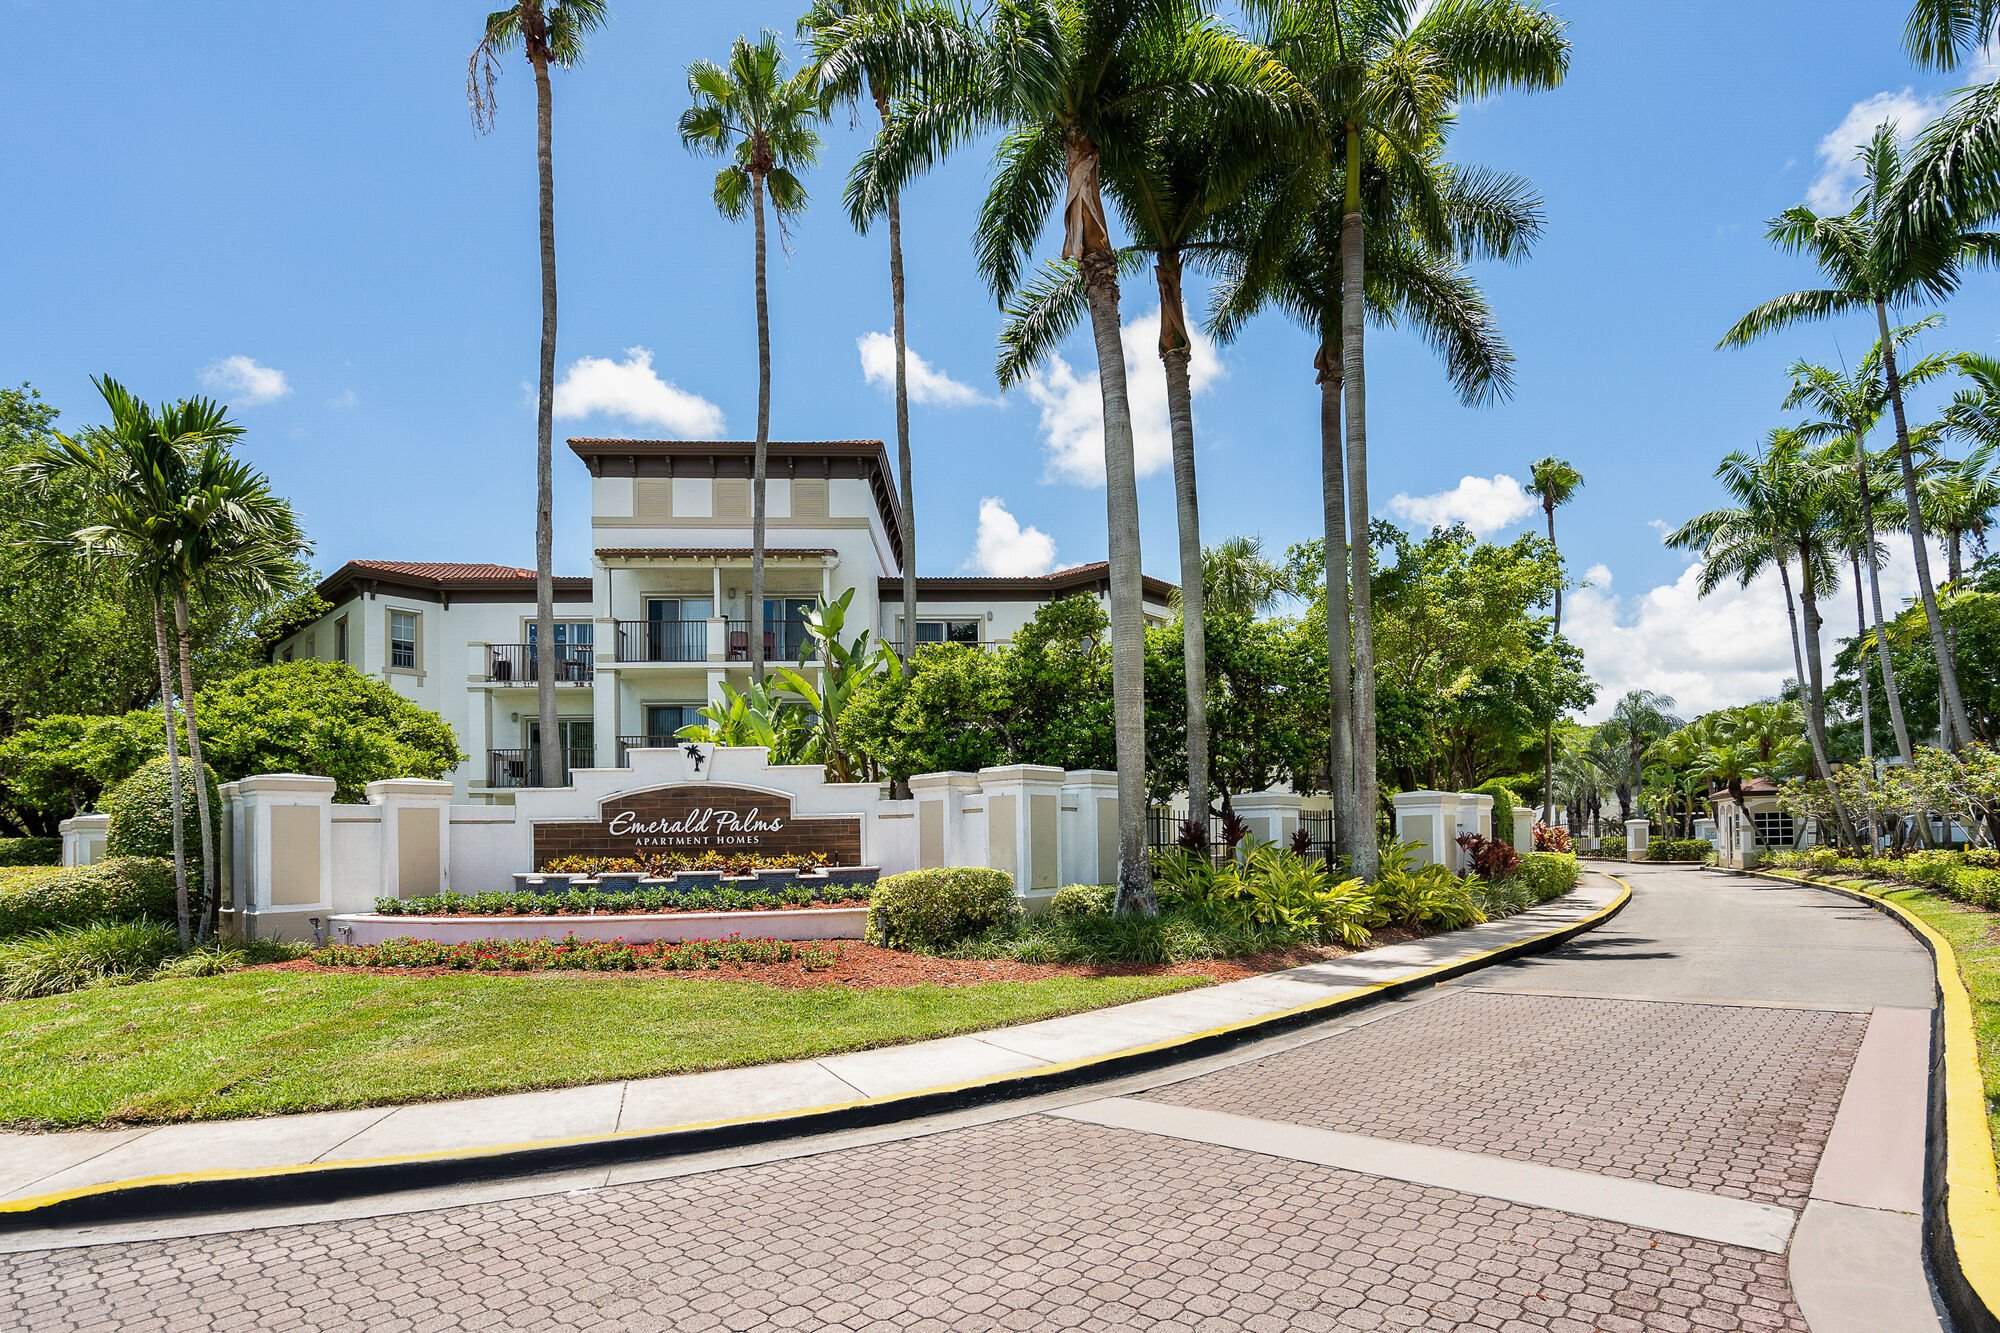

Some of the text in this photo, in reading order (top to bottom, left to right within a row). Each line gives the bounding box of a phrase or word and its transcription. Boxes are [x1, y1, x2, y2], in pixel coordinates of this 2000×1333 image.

[608, 807, 784, 836] Emerald Palms
[635, 836, 760, 846] APARTMENT HOMES
